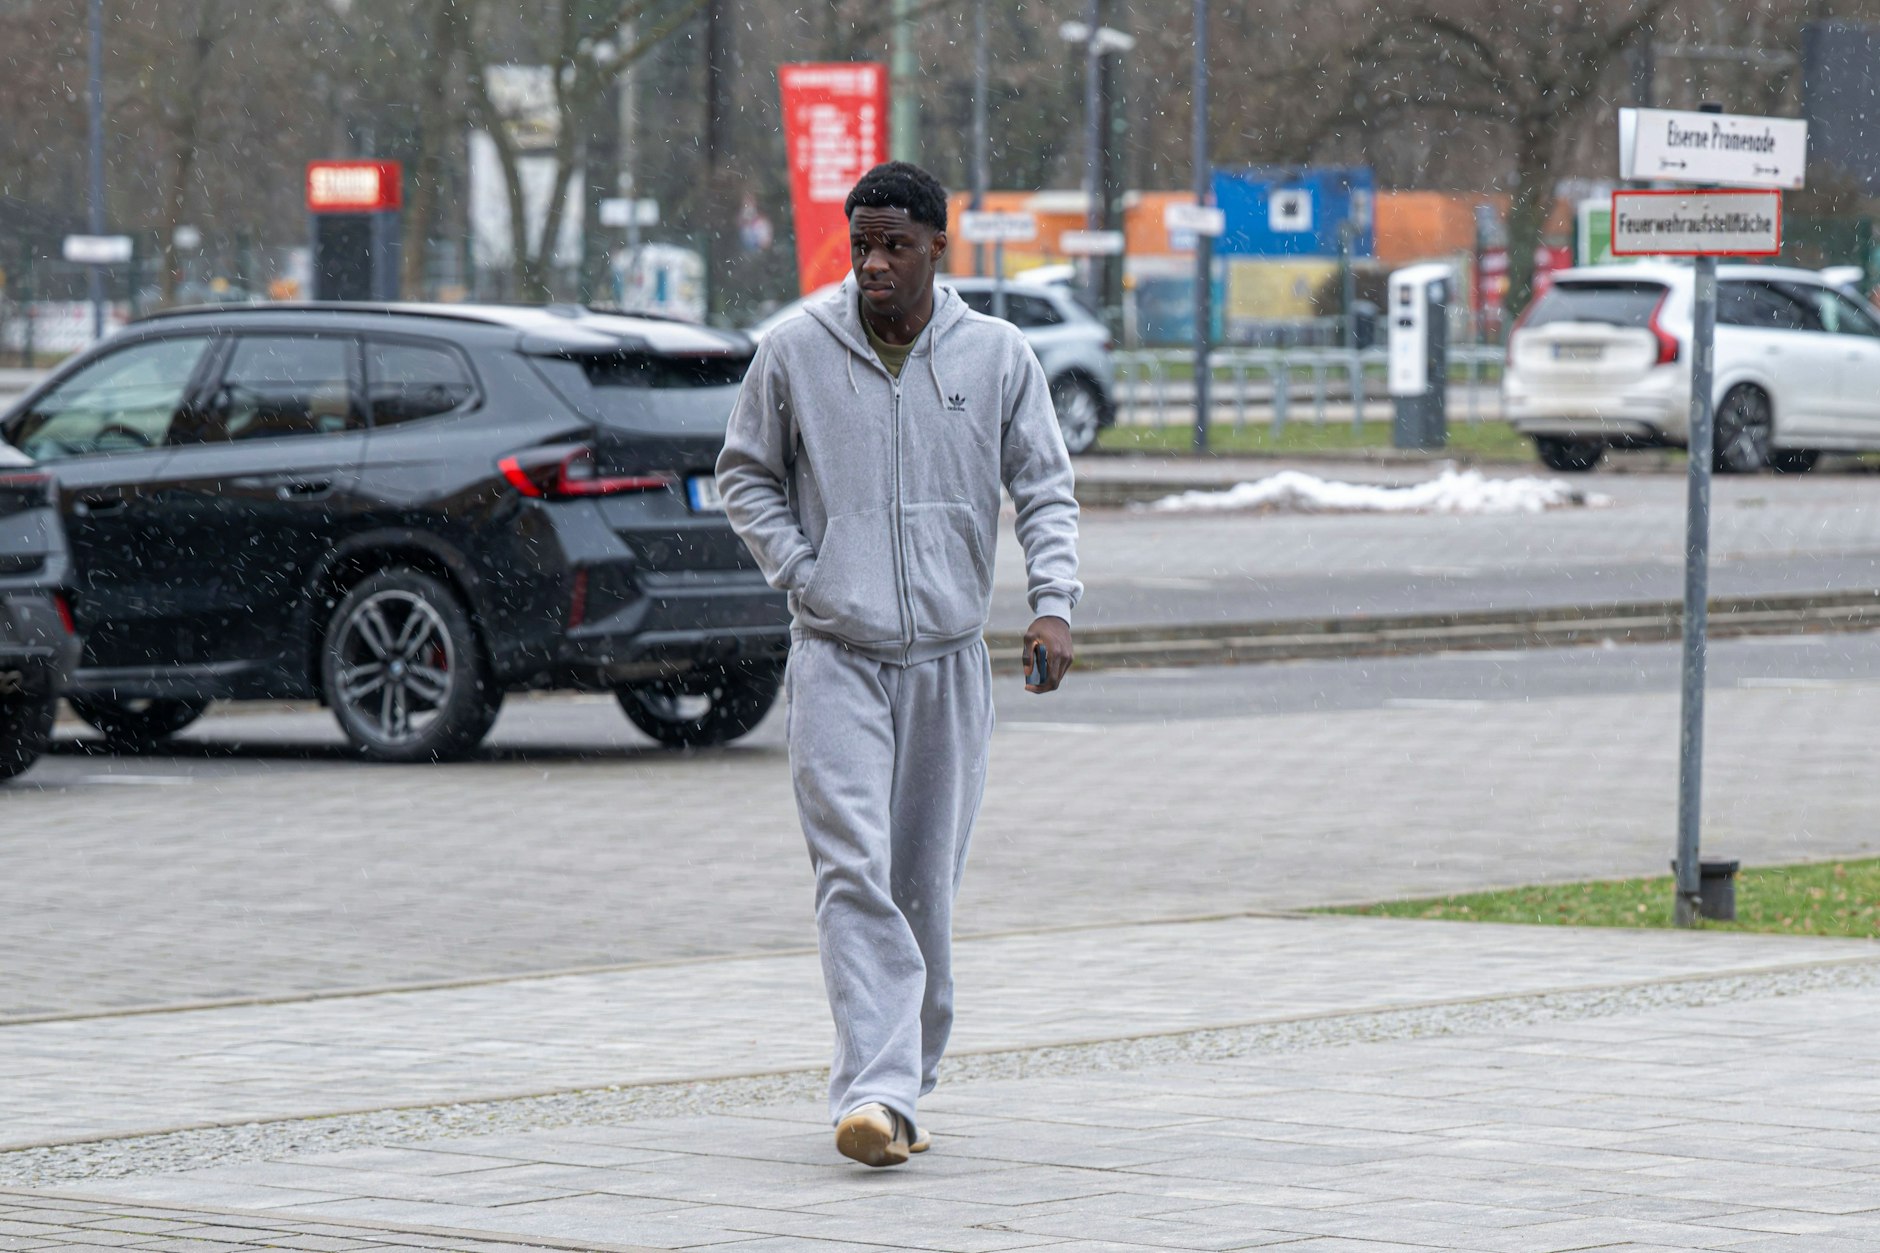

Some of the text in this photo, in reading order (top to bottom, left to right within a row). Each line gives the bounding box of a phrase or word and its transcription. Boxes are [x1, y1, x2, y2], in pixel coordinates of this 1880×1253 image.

[1667, 119, 1776, 153] Eiserne Promenade
[1618, 212, 1773, 234] Feuerwehraufstellfläche
